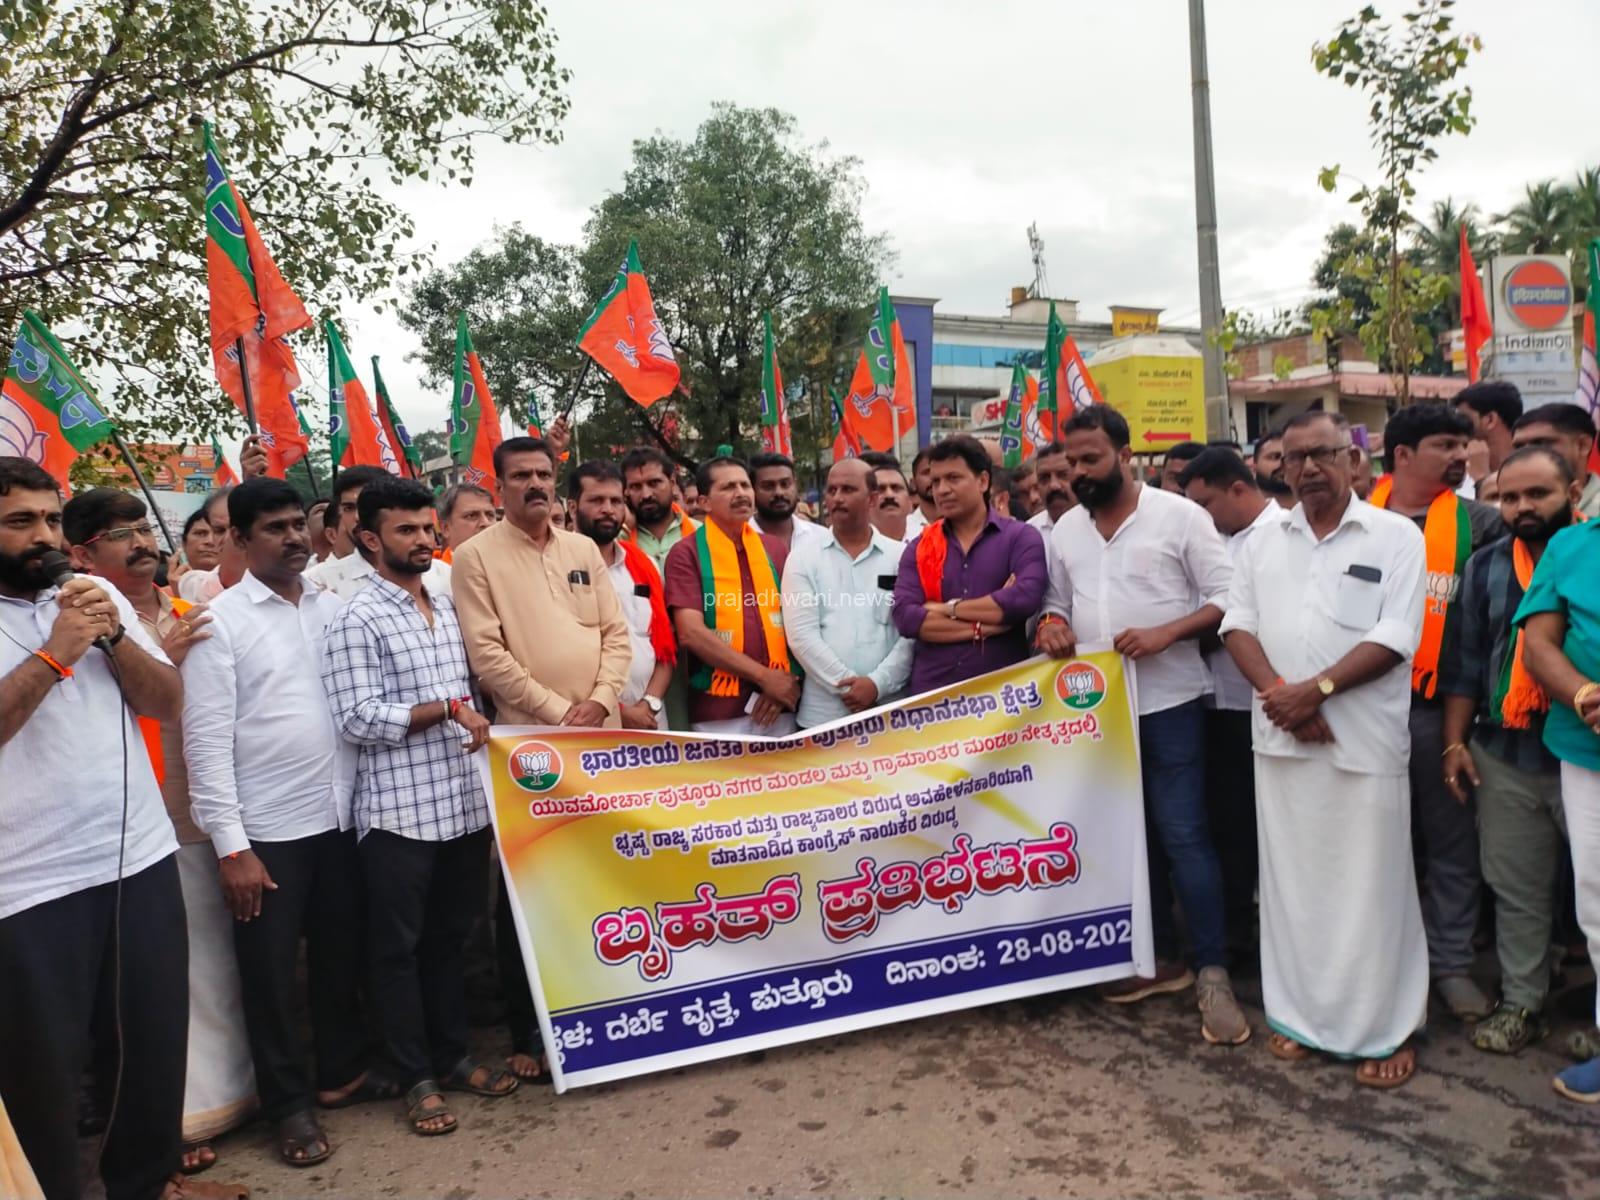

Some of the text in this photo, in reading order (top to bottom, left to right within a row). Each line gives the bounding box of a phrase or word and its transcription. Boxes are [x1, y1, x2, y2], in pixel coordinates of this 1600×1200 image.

[1505, 335, 1571, 349] IndianOil
[532, 711, 1102, 817] ಯುವಮೋರ್ಚಾ ಪುತ್ತೂರು ನಗರ ಮಂಡಲ ಮತ್ತು ಗ್ರಾಮಾಂತರ ಮಂಡಲ ನೇತೃತ್ವದಲ್ಲಿ
[581, 740, 680, 776] ಭಾರತೀಯ
[890, 695, 998, 730] ವಿಧಾನಸಭಾ
[1001, 680, 1042, 715] ಕ್ಷೇತ್ರ
[653, 830, 689, 852] ರಾಜ್ಯ
[692, 819, 743, 844] ಸರಕಾರ
[746, 814, 782, 838] ಮತ್ತು
[782, 799, 859, 832] ರಾಜ್ಯಪಾಲರ
[905, 764, 1034, 808] ಅವಹೇಳನಕಾರಿಯಾಗಿ
[711, 840, 794, 867] ಮಾತನಾಡಿದ
[797, 829, 856, 852] ಕಾಂಗ್ರೆಸ್
[593, 822, 1081, 982] ಬೃಹತ್ ಪ್ರತಿಭಟನೆ
[605, 1007, 669, 1042] ದರ್ಬೆ
[681, 991, 741, 1036] ವೃತ್ತ,
[750, 968, 854, 1009] ಪುತ್ತೂರು
[885, 944, 986, 986] ದಿನಾಂಕ:
